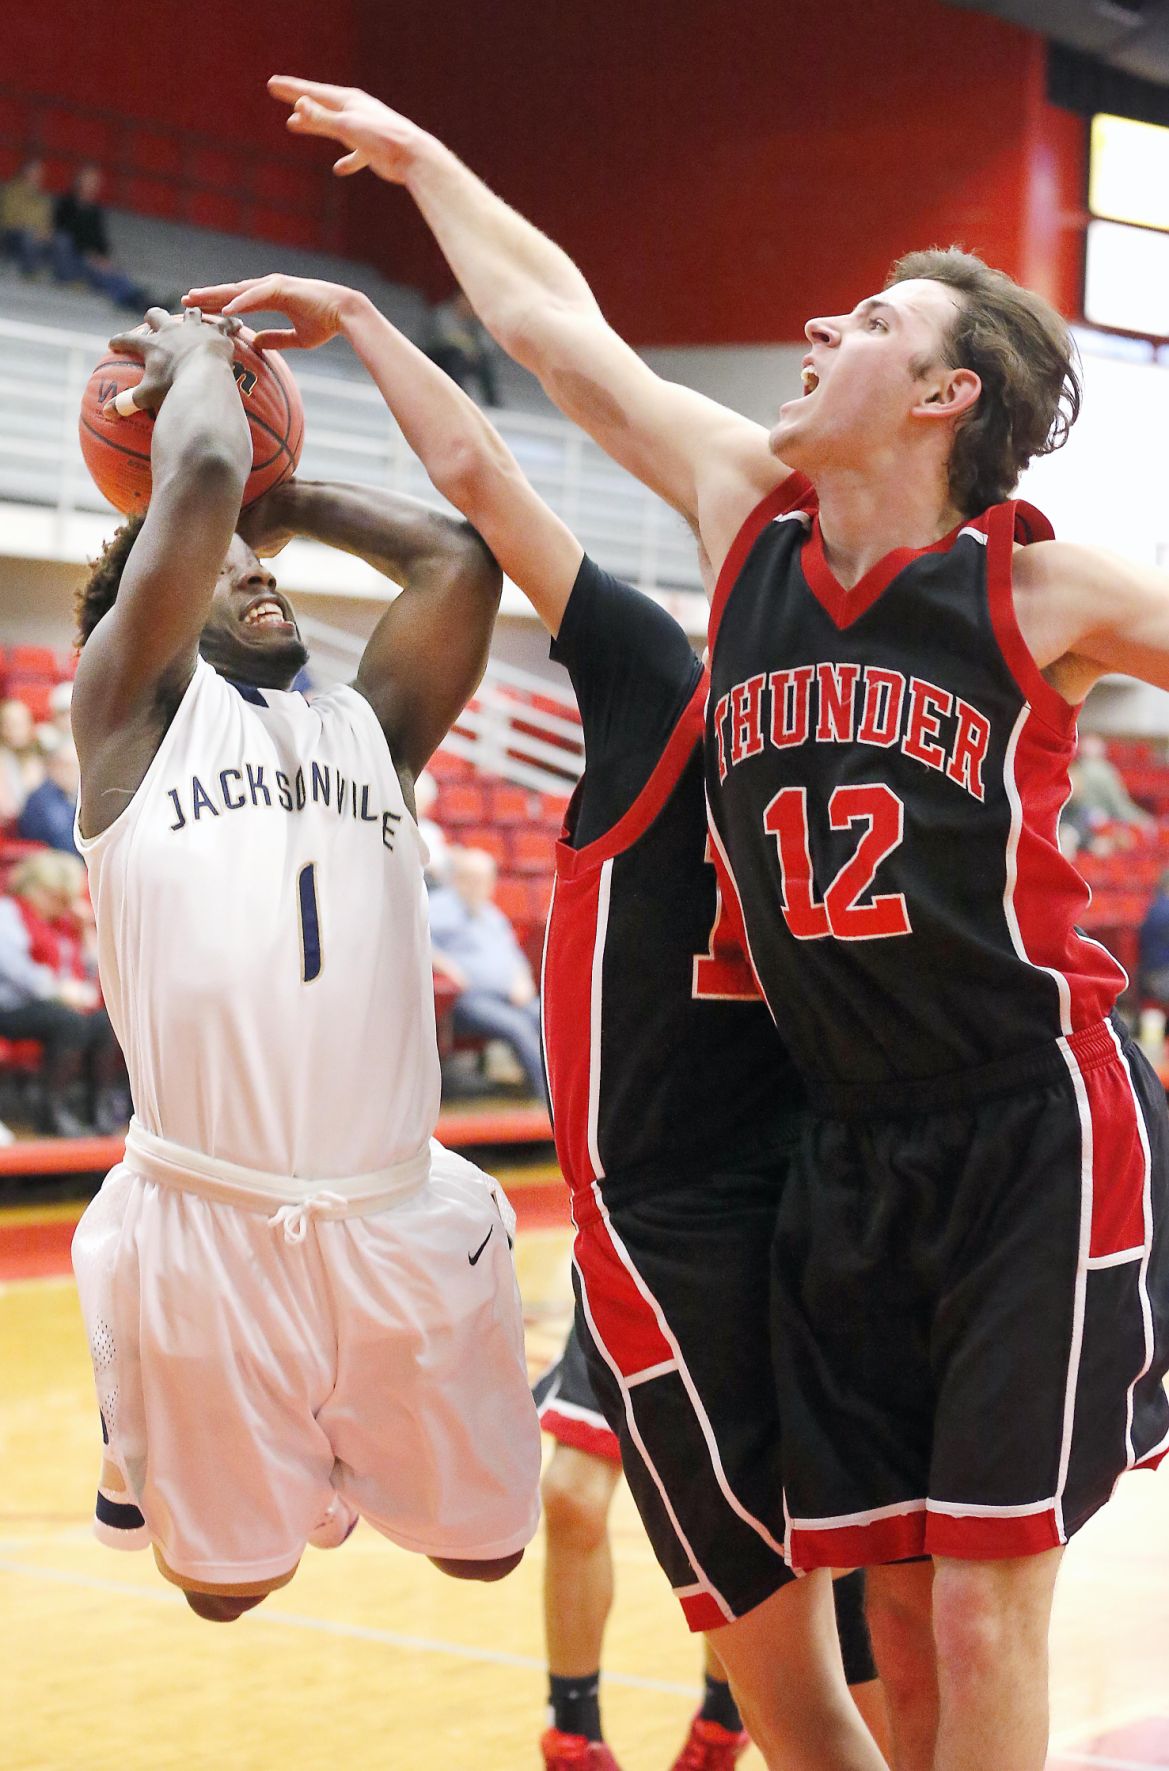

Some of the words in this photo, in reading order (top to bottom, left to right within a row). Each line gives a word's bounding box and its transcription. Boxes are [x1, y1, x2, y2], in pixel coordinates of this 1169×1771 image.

[714, 662, 991, 803] THUNDER
[167, 760, 401, 852] JACKSONVILE
[763, 783, 913, 941] 12
[297, 859, 324, 985] 1
